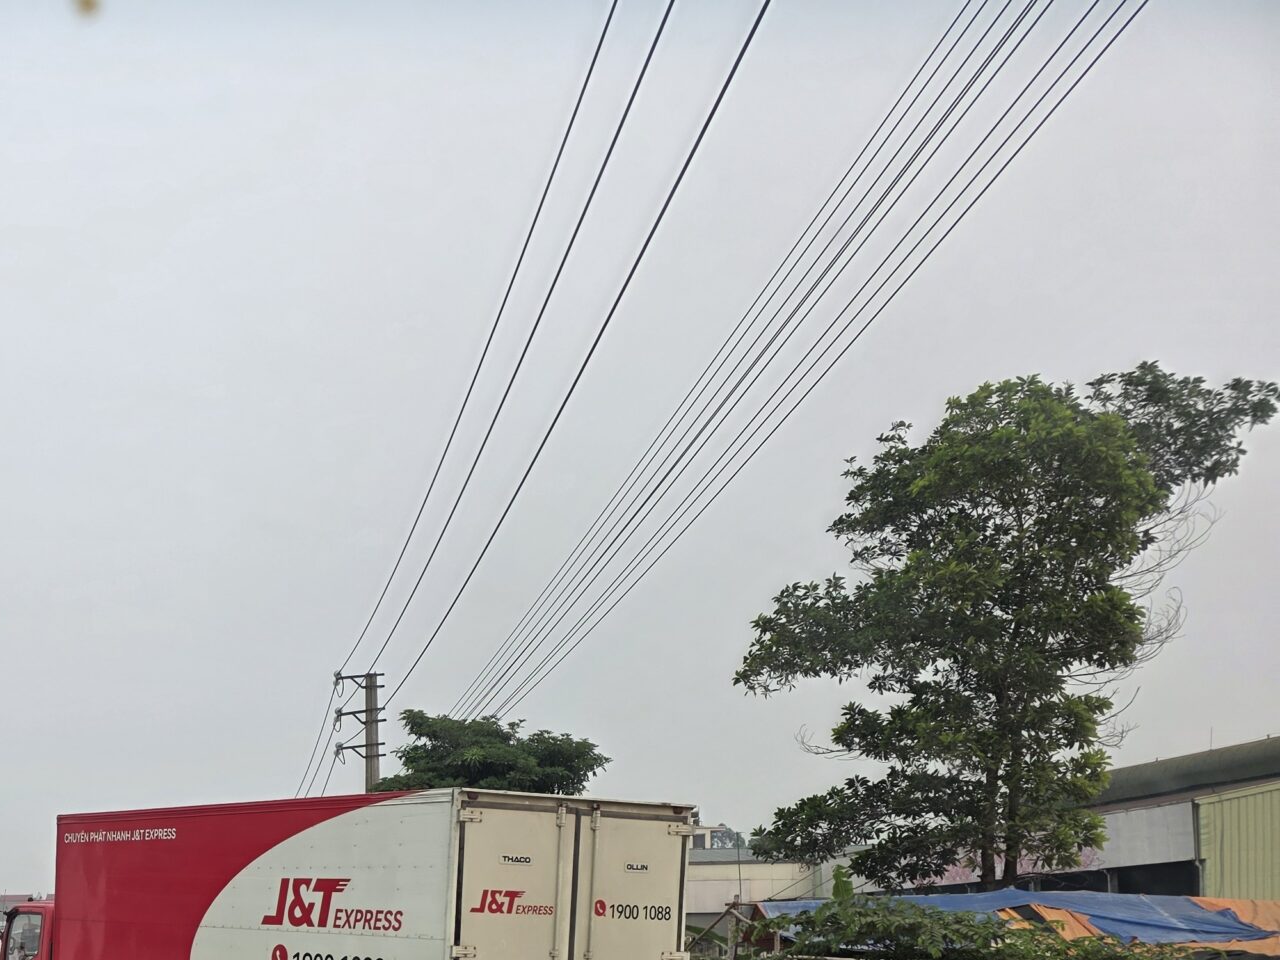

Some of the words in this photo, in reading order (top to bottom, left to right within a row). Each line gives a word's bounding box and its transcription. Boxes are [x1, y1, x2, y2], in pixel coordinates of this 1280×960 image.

[107, 831, 131, 841] NHANH
[132, 829, 144, 841] J&T
[145, 828, 177, 840] EXPRESS
[502, 855, 531, 863] THACO
[626, 863, 648, 871] OLLIN
[261, 878, 352, 928] J&T
[333, 908, 404, 931] EXPRESS
[469, 889, 526, 914] J&T
[515, 905, 554, 915] EXPRESS
[609, 904, 639, 919] 1900
[642, 905, 671, 920] 1088
